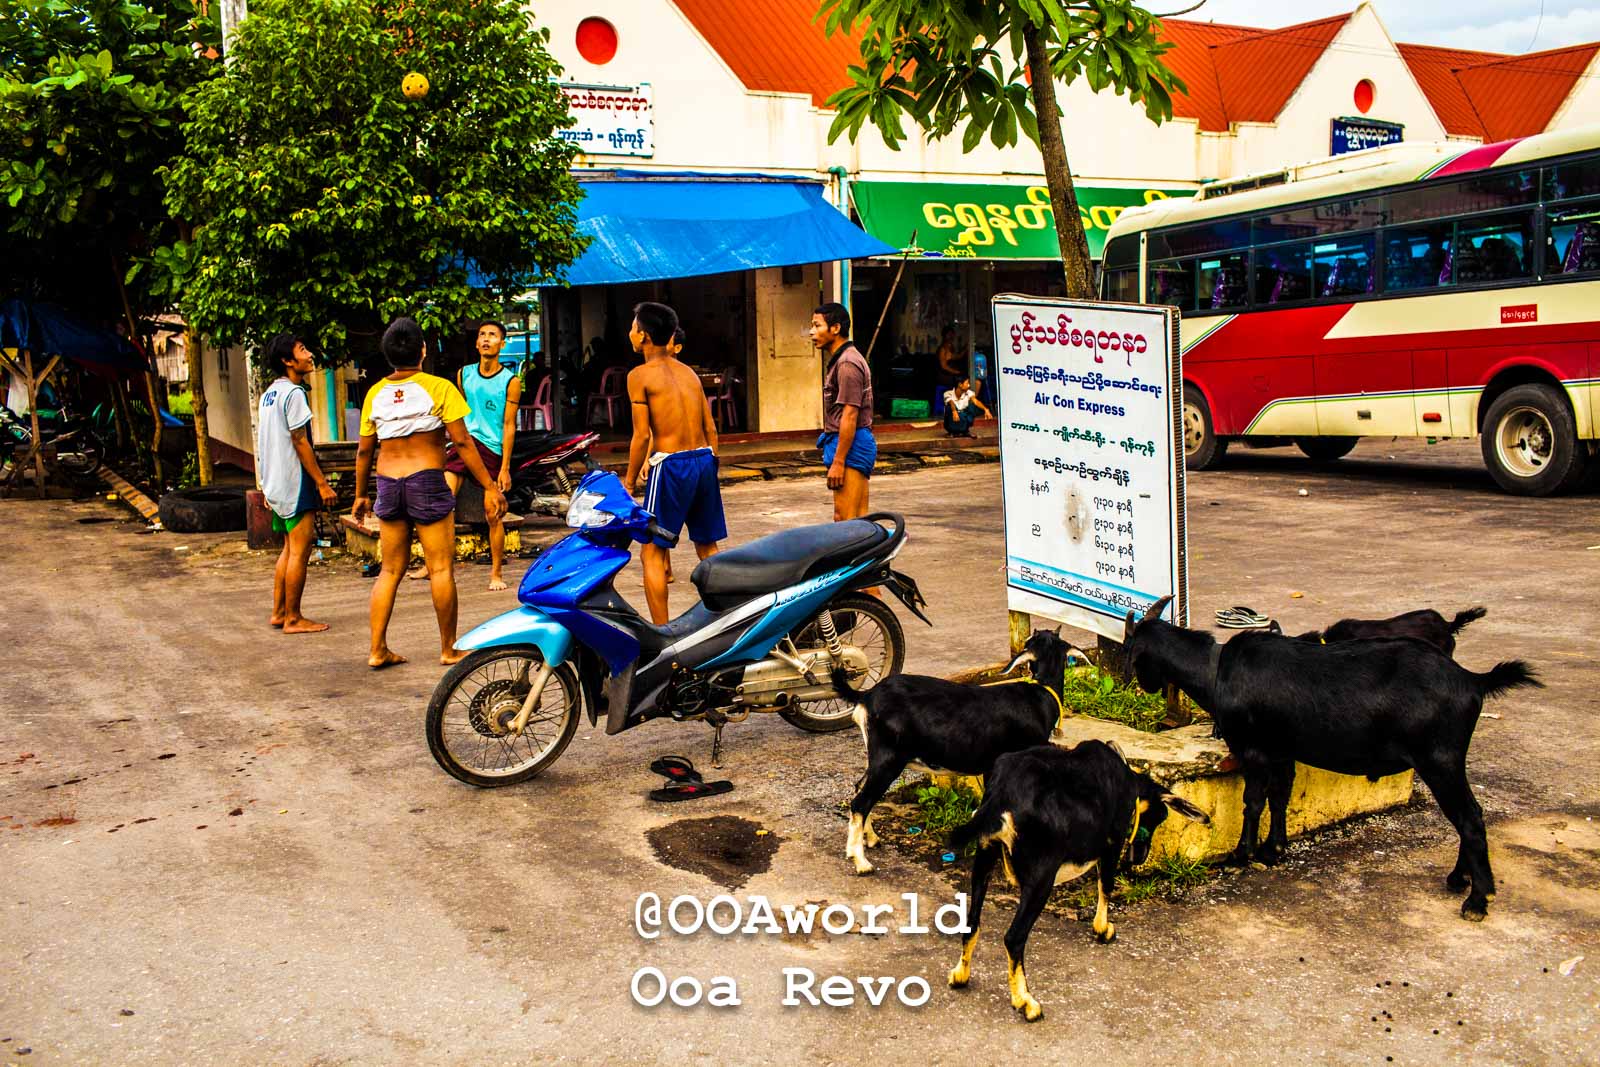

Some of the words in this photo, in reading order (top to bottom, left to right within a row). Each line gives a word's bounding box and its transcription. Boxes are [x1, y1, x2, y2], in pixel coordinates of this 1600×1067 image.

[608, 128, 647, 149] ရန်ကုန်
[1010, 311, 1148, 367] ပွင့်သစ်စရတနာ
[1034, 392, 1050, 405] Air
[1053, 394, 1075, 409] Con
[1077, 398, 1126, 417] Express
[1119, 437, 1156, 457] ရန်ကုန်
[1030, 479, 1050, 496] နံနက်
[1116, 498, 1133, 518] နာရီ
[1031, 523, 1041, 537] ည
[1117, 521, 1134, 540] နာရီ
[1118, 543, 1135, 562] နာရီ
[1119, 564, 1136, 584] နာရီ
